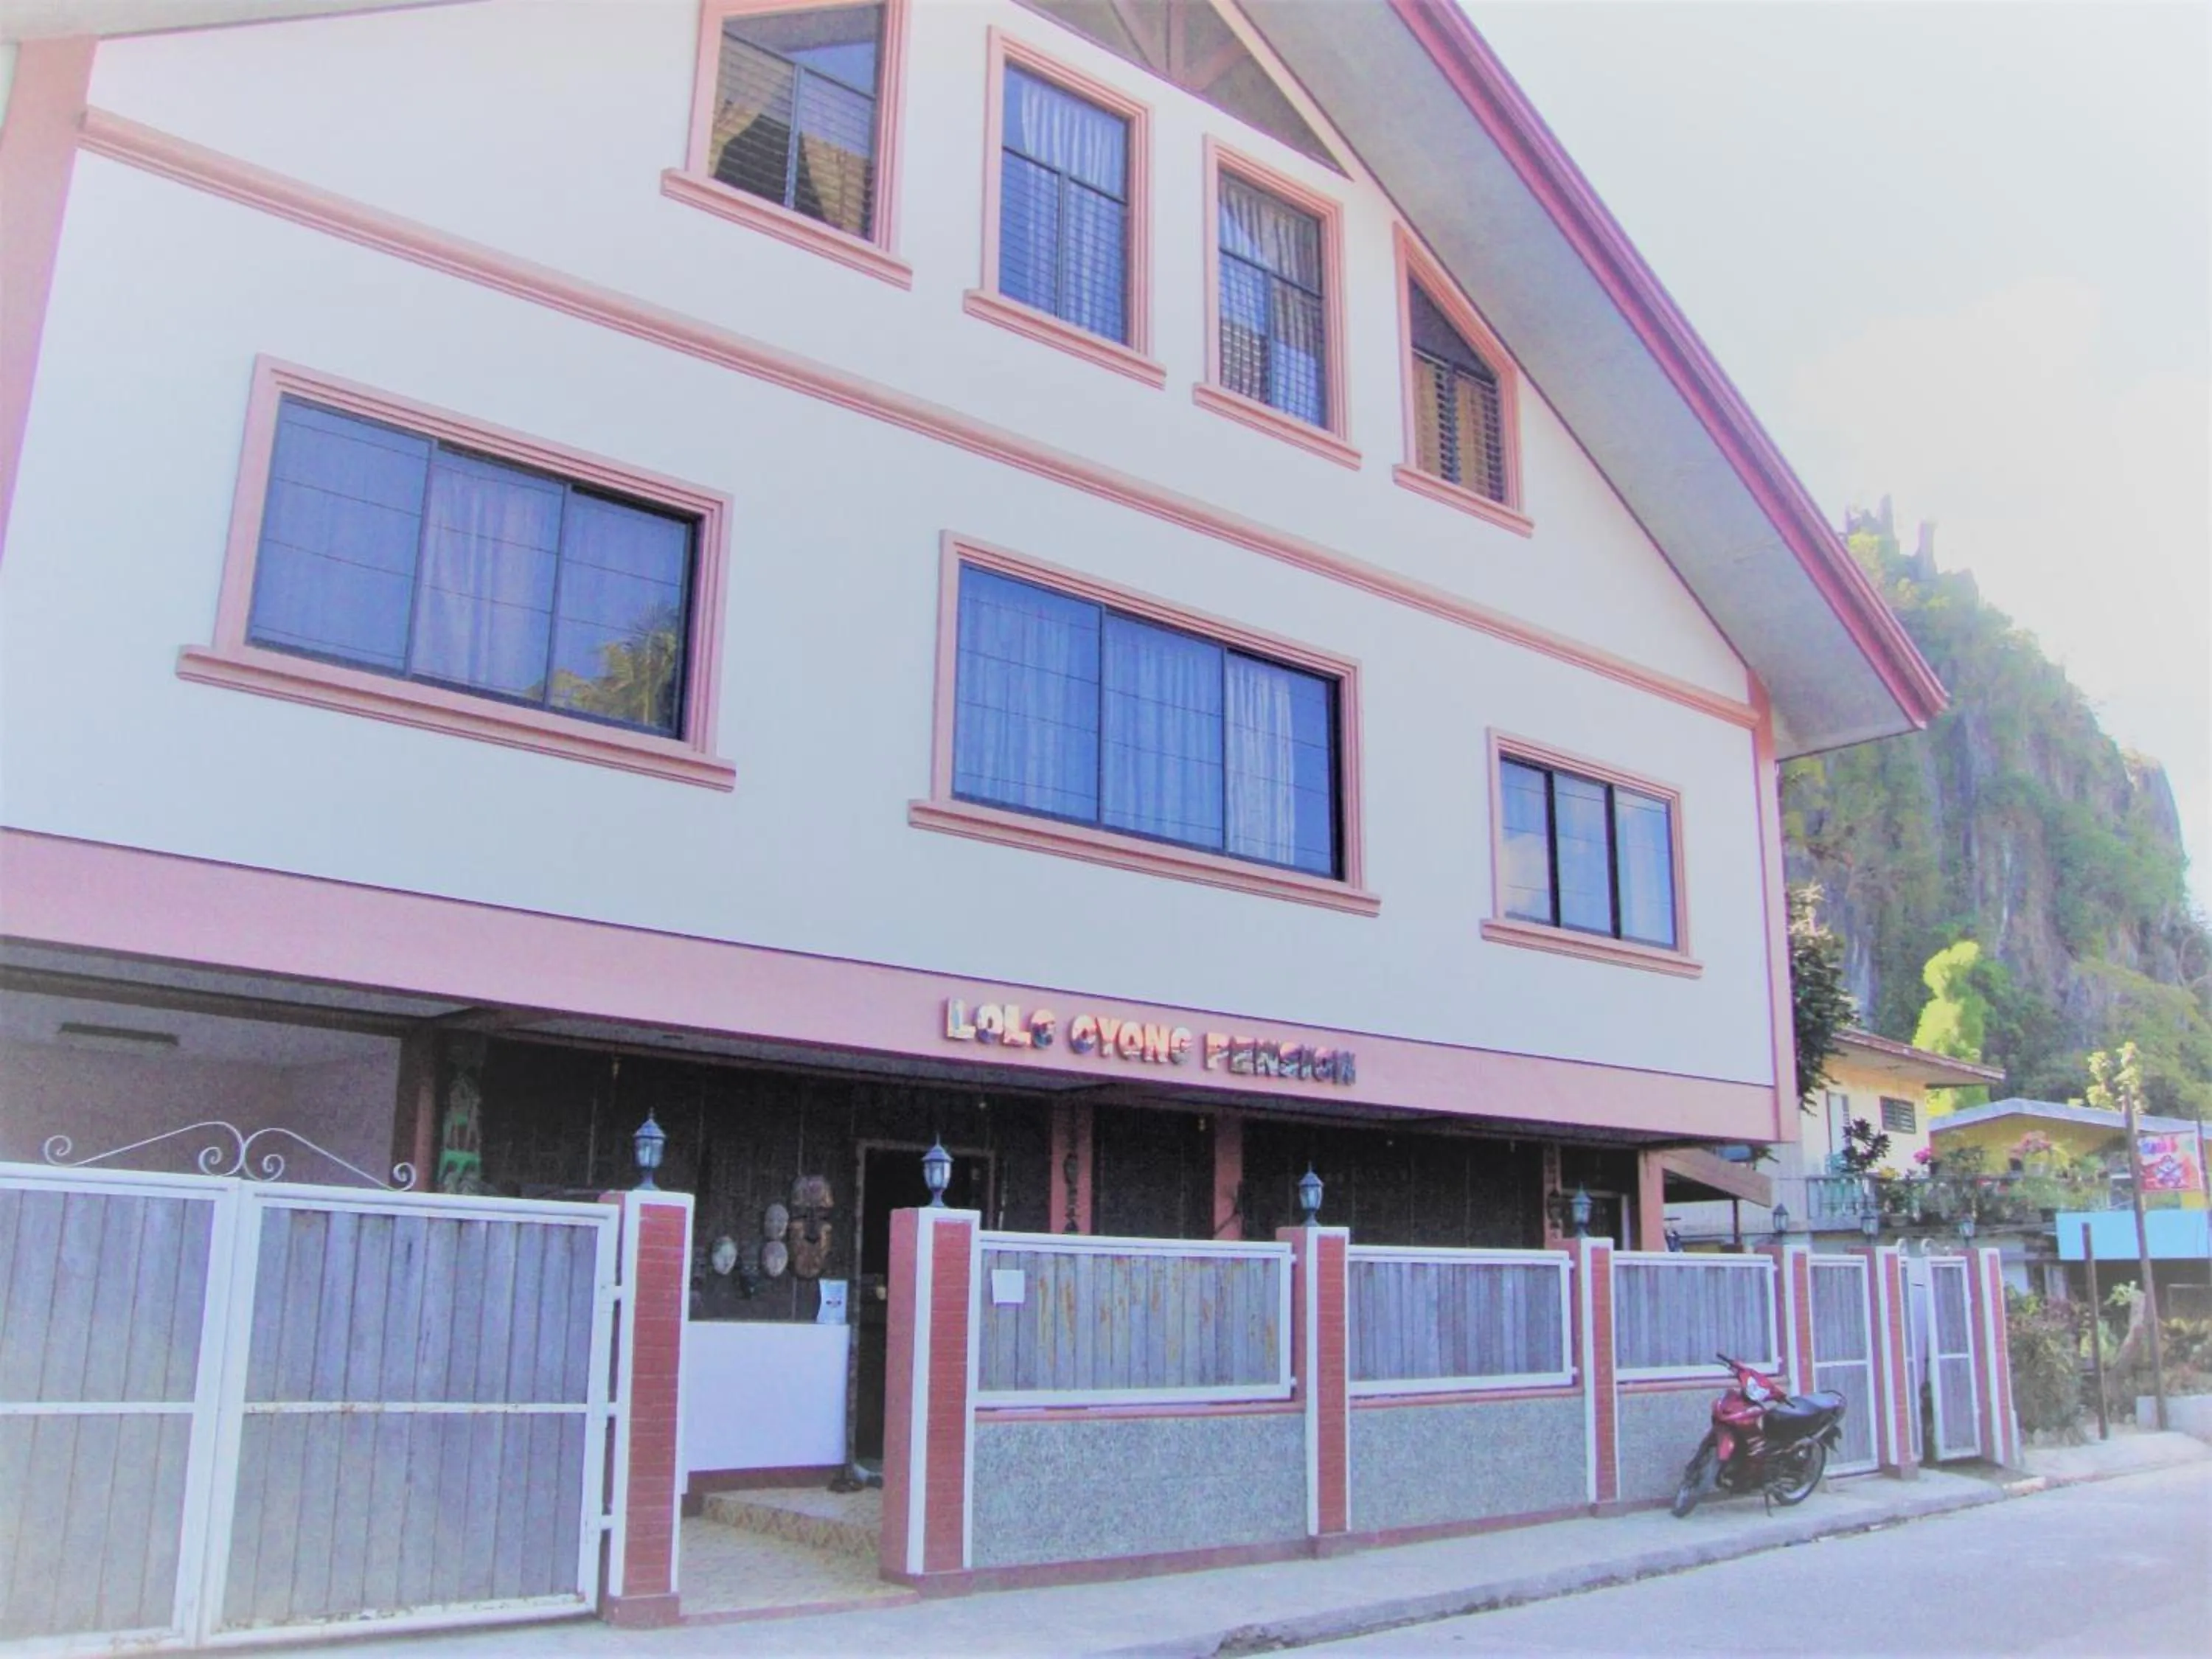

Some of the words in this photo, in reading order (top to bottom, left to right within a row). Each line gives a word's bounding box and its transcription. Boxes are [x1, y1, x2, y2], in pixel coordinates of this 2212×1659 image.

[945, 997, 1056, 1049] LOLO
[1069, 1014, 1192, 1064] OYONG
[1203, 1032, 1357, 1085] PENSION
